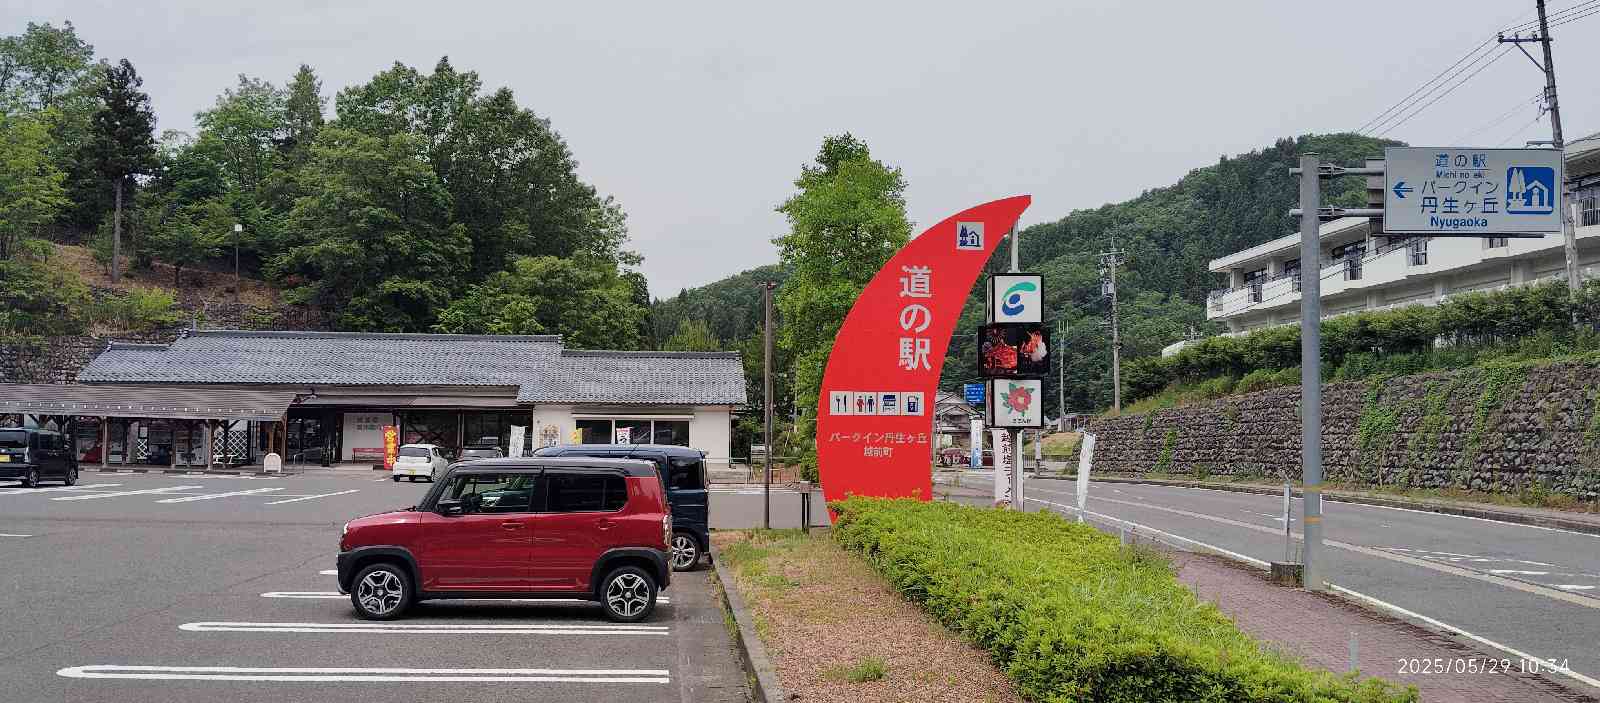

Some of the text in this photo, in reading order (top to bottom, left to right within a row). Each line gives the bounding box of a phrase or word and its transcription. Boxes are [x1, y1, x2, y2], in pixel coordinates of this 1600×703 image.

[1435, 153, 1487, 168] 道の駅
[1436, 170, 1456, 179] Michi
[1421, 181, 1498, 195] パークイン
[1420, 196, 1499, 214] 丹生ヶ丘
[1430, 217, 1488, 229] Nyugaoka
[899, 265, 932, 371] 道の駅
[829, 432, 928, 444] パークイン丹生ヶ丘
[863, 446, 894, 457] 越前町
